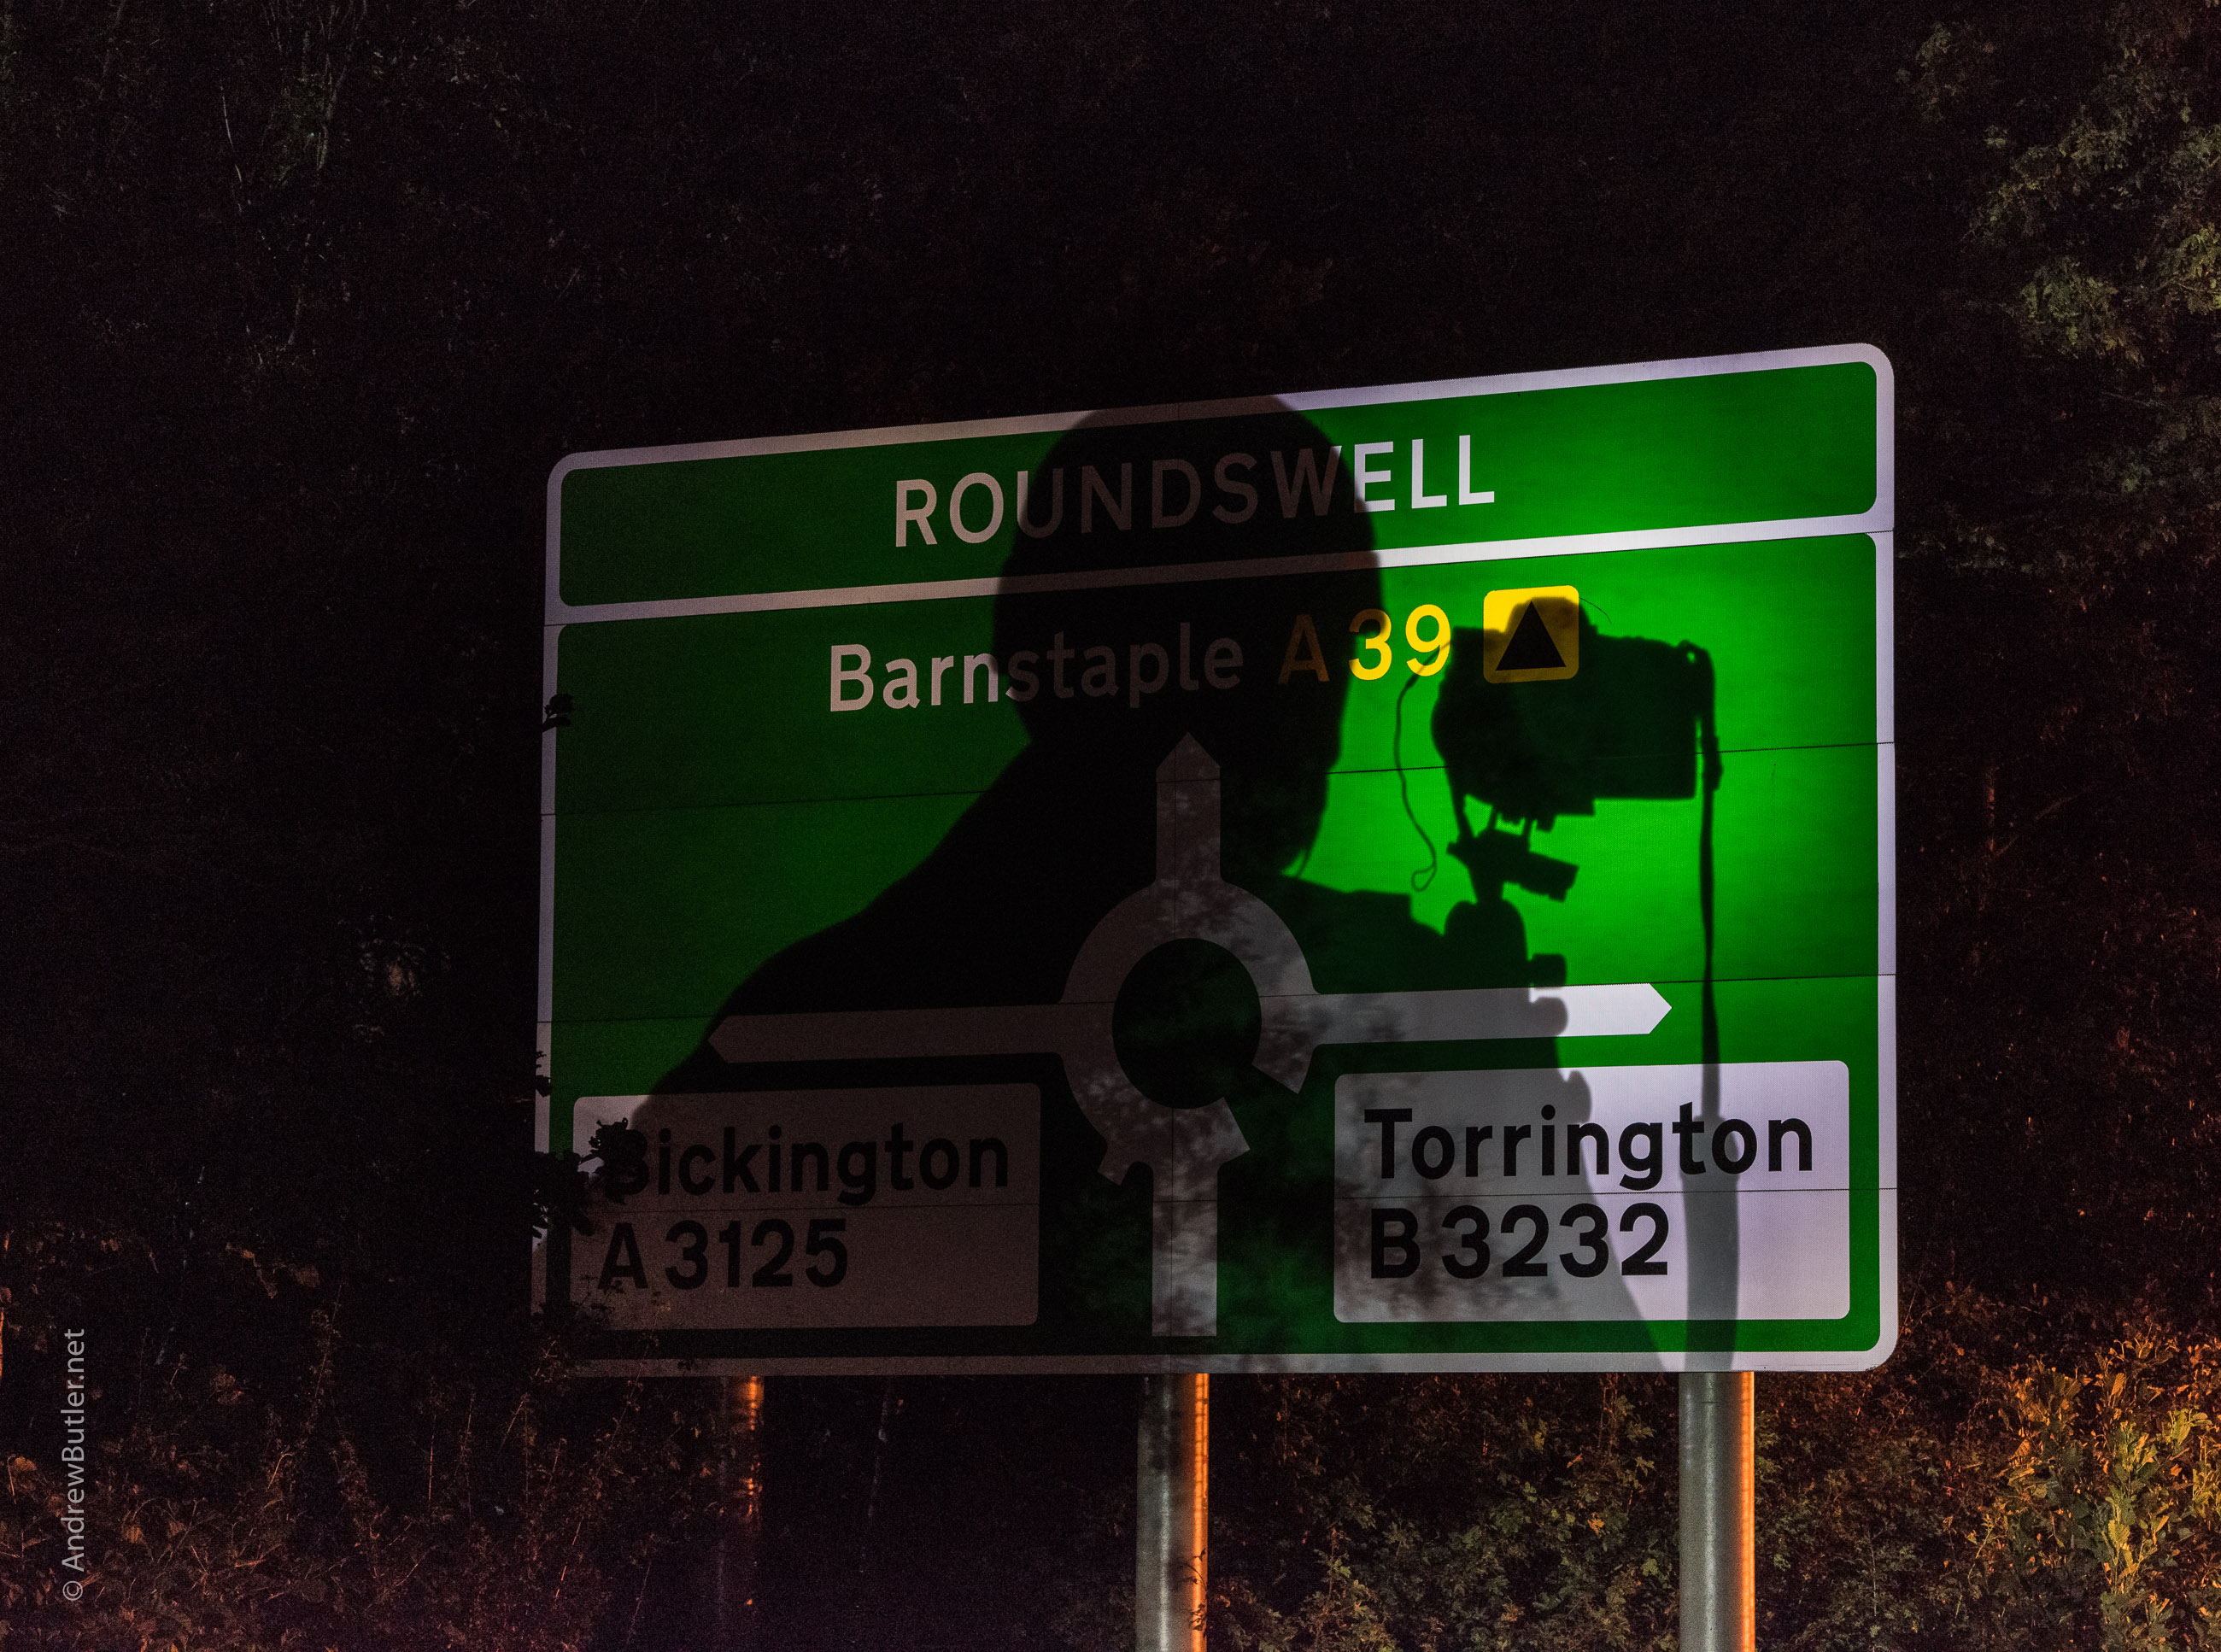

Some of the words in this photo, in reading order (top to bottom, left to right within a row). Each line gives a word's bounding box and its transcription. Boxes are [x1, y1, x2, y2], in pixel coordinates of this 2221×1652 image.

[894, 434, 1496, 548] ROUNDSWELL
[829, 622, 1244, 712] Barnstaple
[1277, 613, 1331, 684] A
[1347, 603, 1452, 682] 39
[1364, 1101, 1813, 1191] Torrington
[597, 1221, 649, 1290] A
[664, 1218, 848, 1290] 3125
[1370, 1207, 1421, 1279] B
[1441, 1202, 1670, 1279] 3232
